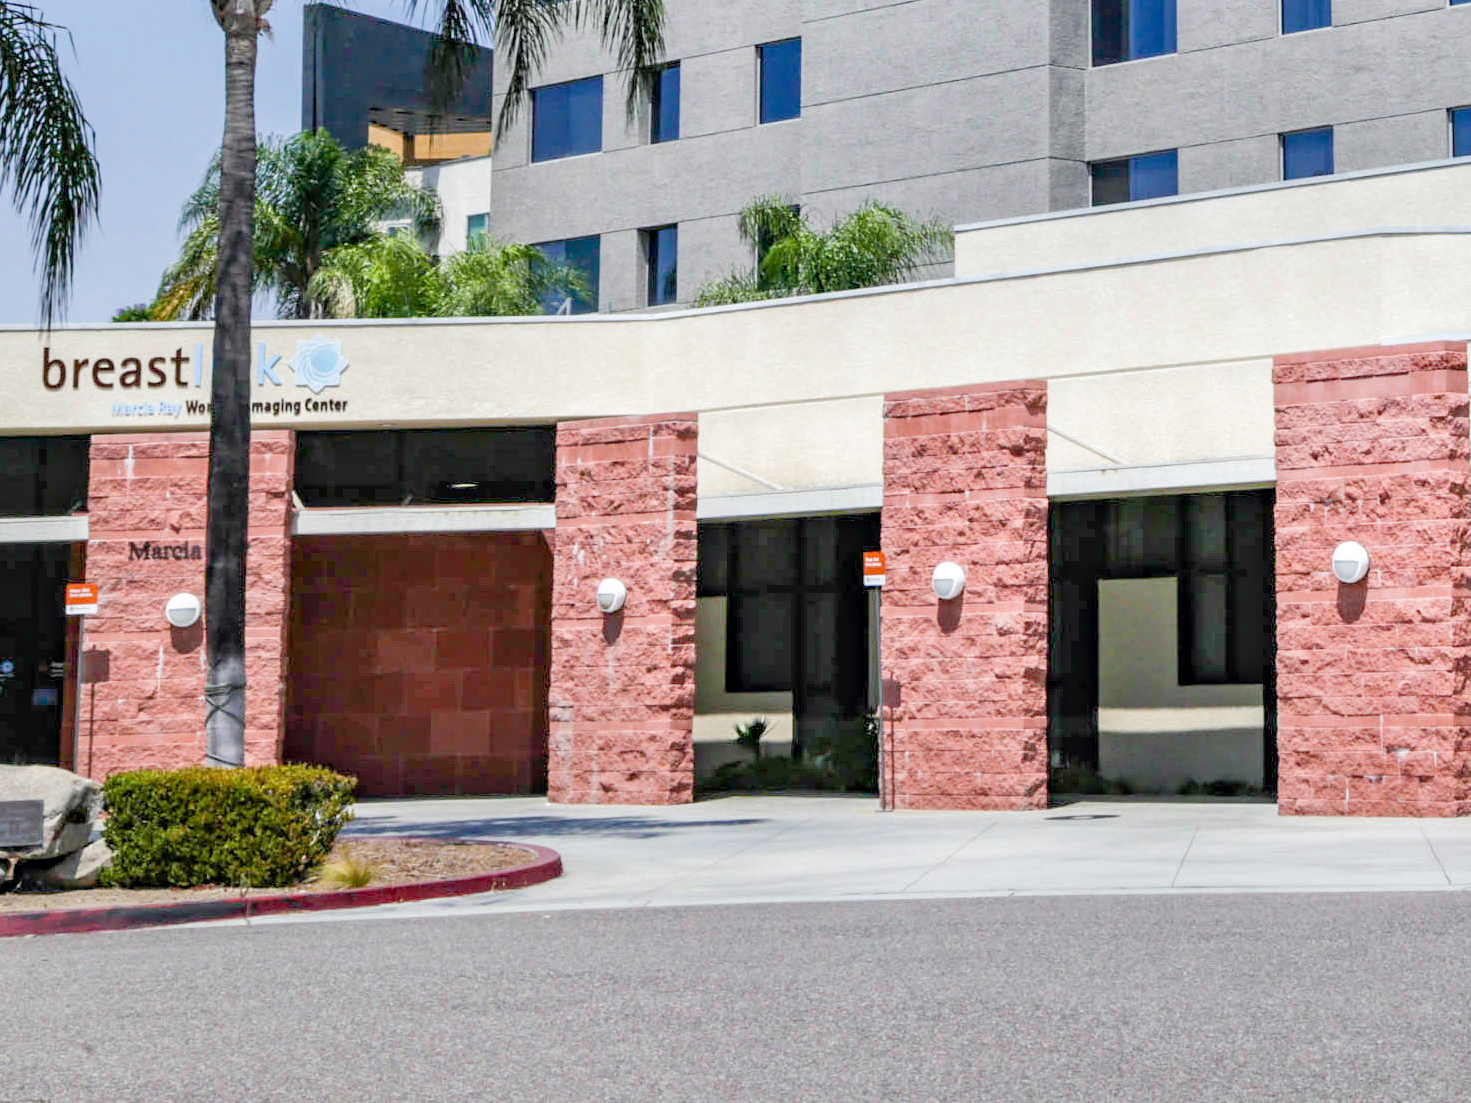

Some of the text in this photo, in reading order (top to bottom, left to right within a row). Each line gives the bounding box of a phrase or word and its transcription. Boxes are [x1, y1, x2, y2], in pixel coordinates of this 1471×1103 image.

[42, 342, 282, 390] breastlk
[112, 401, 155, 417] Marcia
[157, 401, 181, 419] Ray
[251, 398, 301, 416] maging
[304, 398, 348, 412] Center
[128, 541, 202, 561] Marcia
